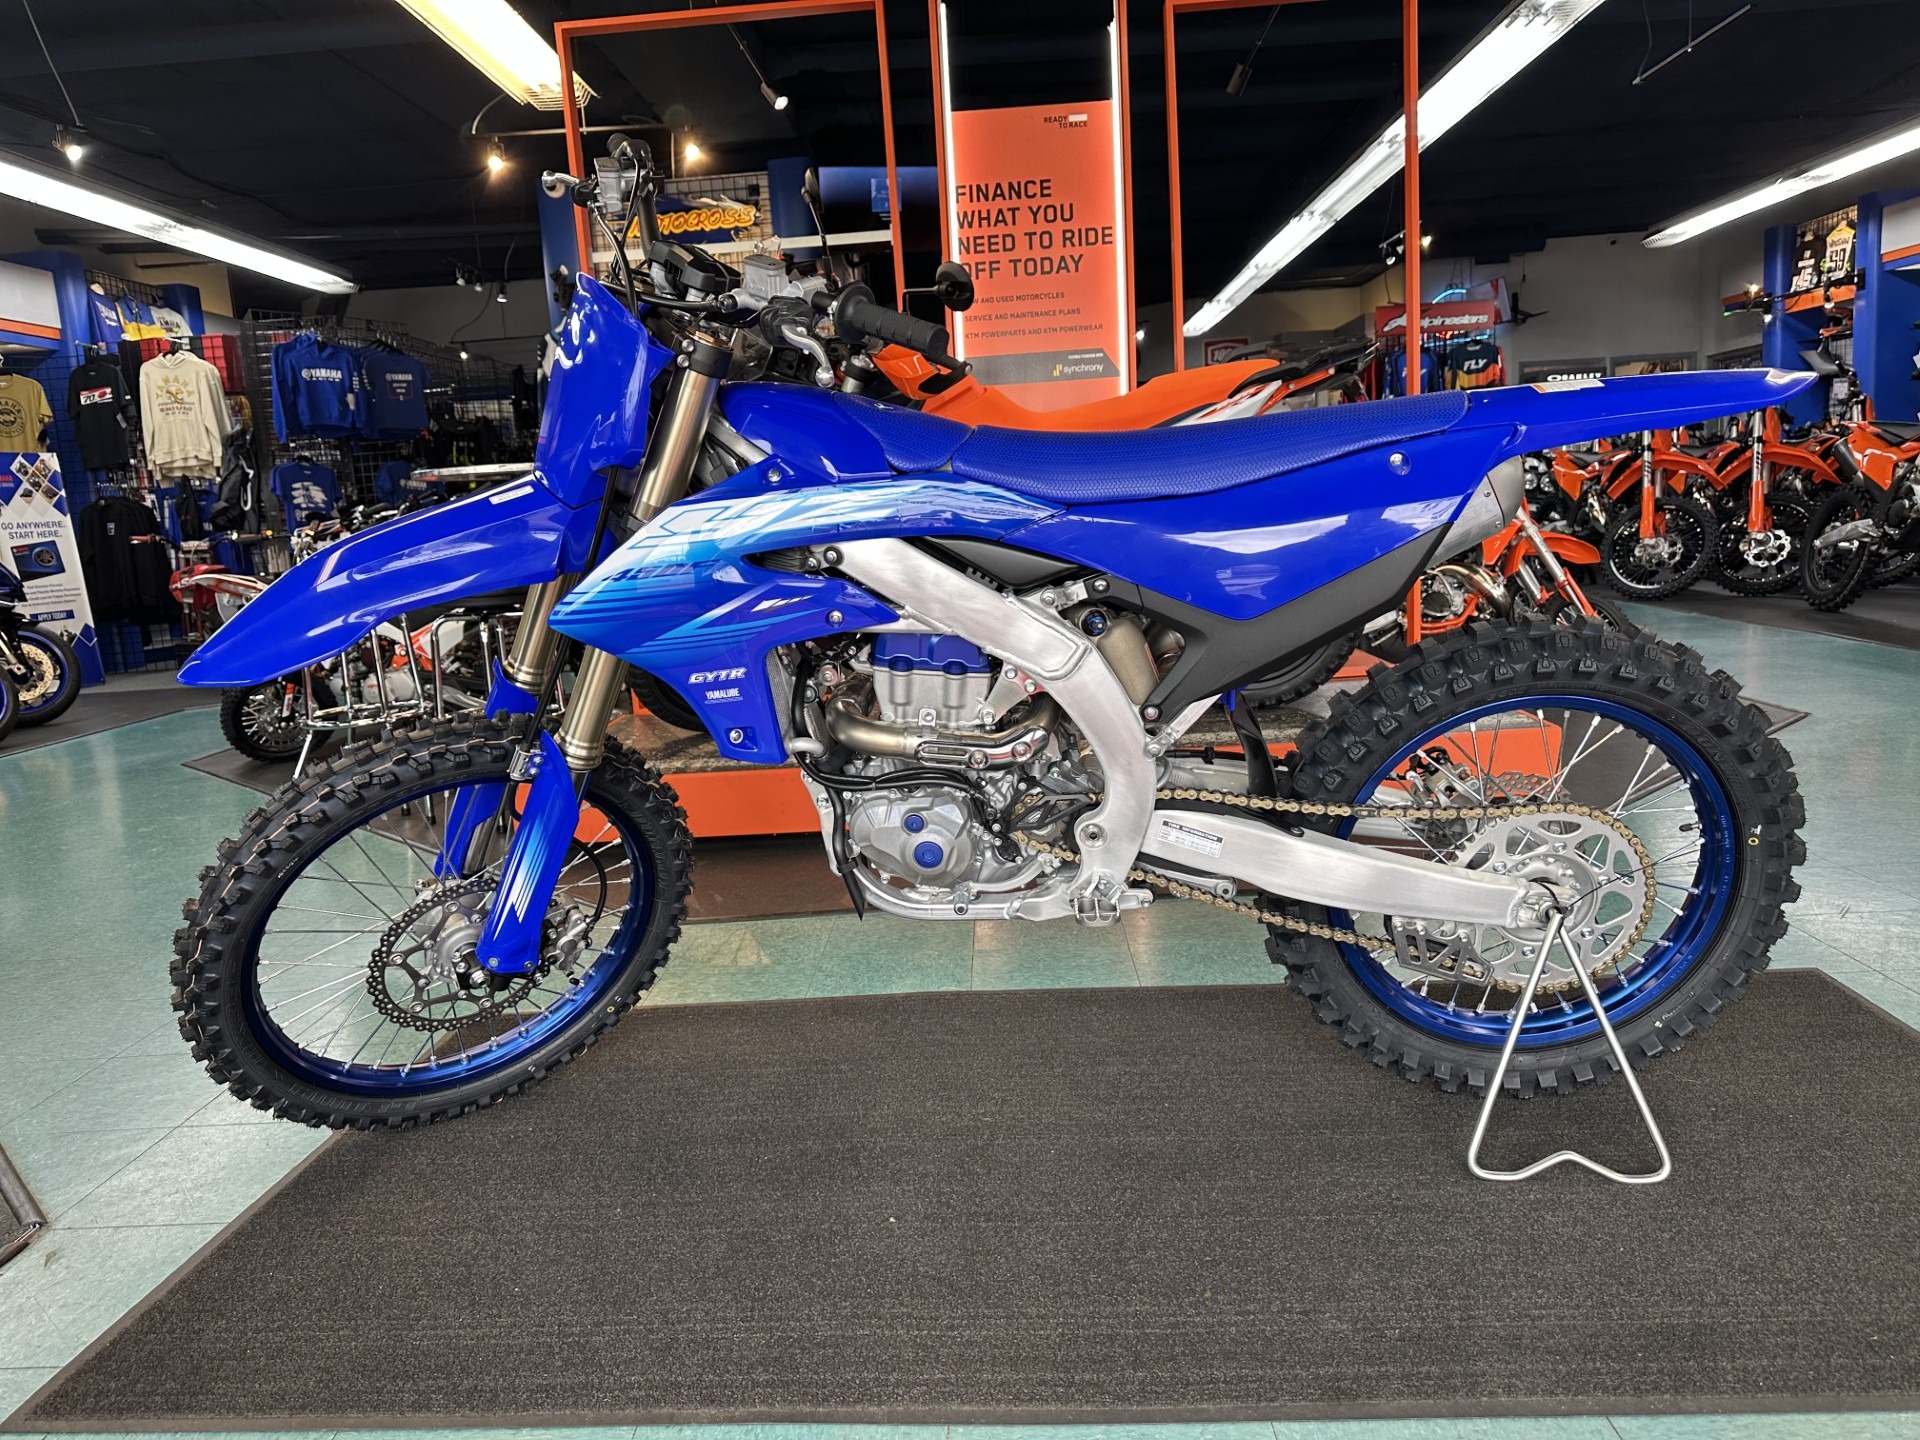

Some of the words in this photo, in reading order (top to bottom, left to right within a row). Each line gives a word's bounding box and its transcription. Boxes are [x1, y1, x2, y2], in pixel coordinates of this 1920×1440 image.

[1043, 115, 1068, 124] READY
[1069, 120, 1088, 128] RACE
[955, 178, 1052, 203] FINANCE
[957, 207, 1020, 229] WHAT
[1028, 203, 1074, 224] YOU
[958, 233, 1016, 255] NEED
[1024, 231, 1053, 250] TO
[1062, 226, 1113, 248] RIDE
[1009, 254, 1084, 277] TODAY
[996, 295, 1015, 303] USED
[1016, 292, 1065, 302] MOTORCYCLES
[964, 314, 992, 322] SERVICE
[994, 313, 1009, 321] AND
[1010, 310, 1057, 319] MAINTENANCE
[1058, 308, 1081, 316] PLANS
[981, 329, 1026, 338] POWERPARTS
[1043, 326, 1058, 334] KTM
[1059, 324, 1103, 333] POWERWEAR
[1063, 363, 1104, 374] synchrony
[1463, 359, 1487, 371] FLY
[1, 522, 13, 530] GO
[16, 520, 66, 530] ANYWHERE.
[8, 531, 34, 540] START
[37, 530, 63, 538] HERE.
[688, 667, 747, 684] GYTR
[705, 688, 740, 699] YAMALUBE
